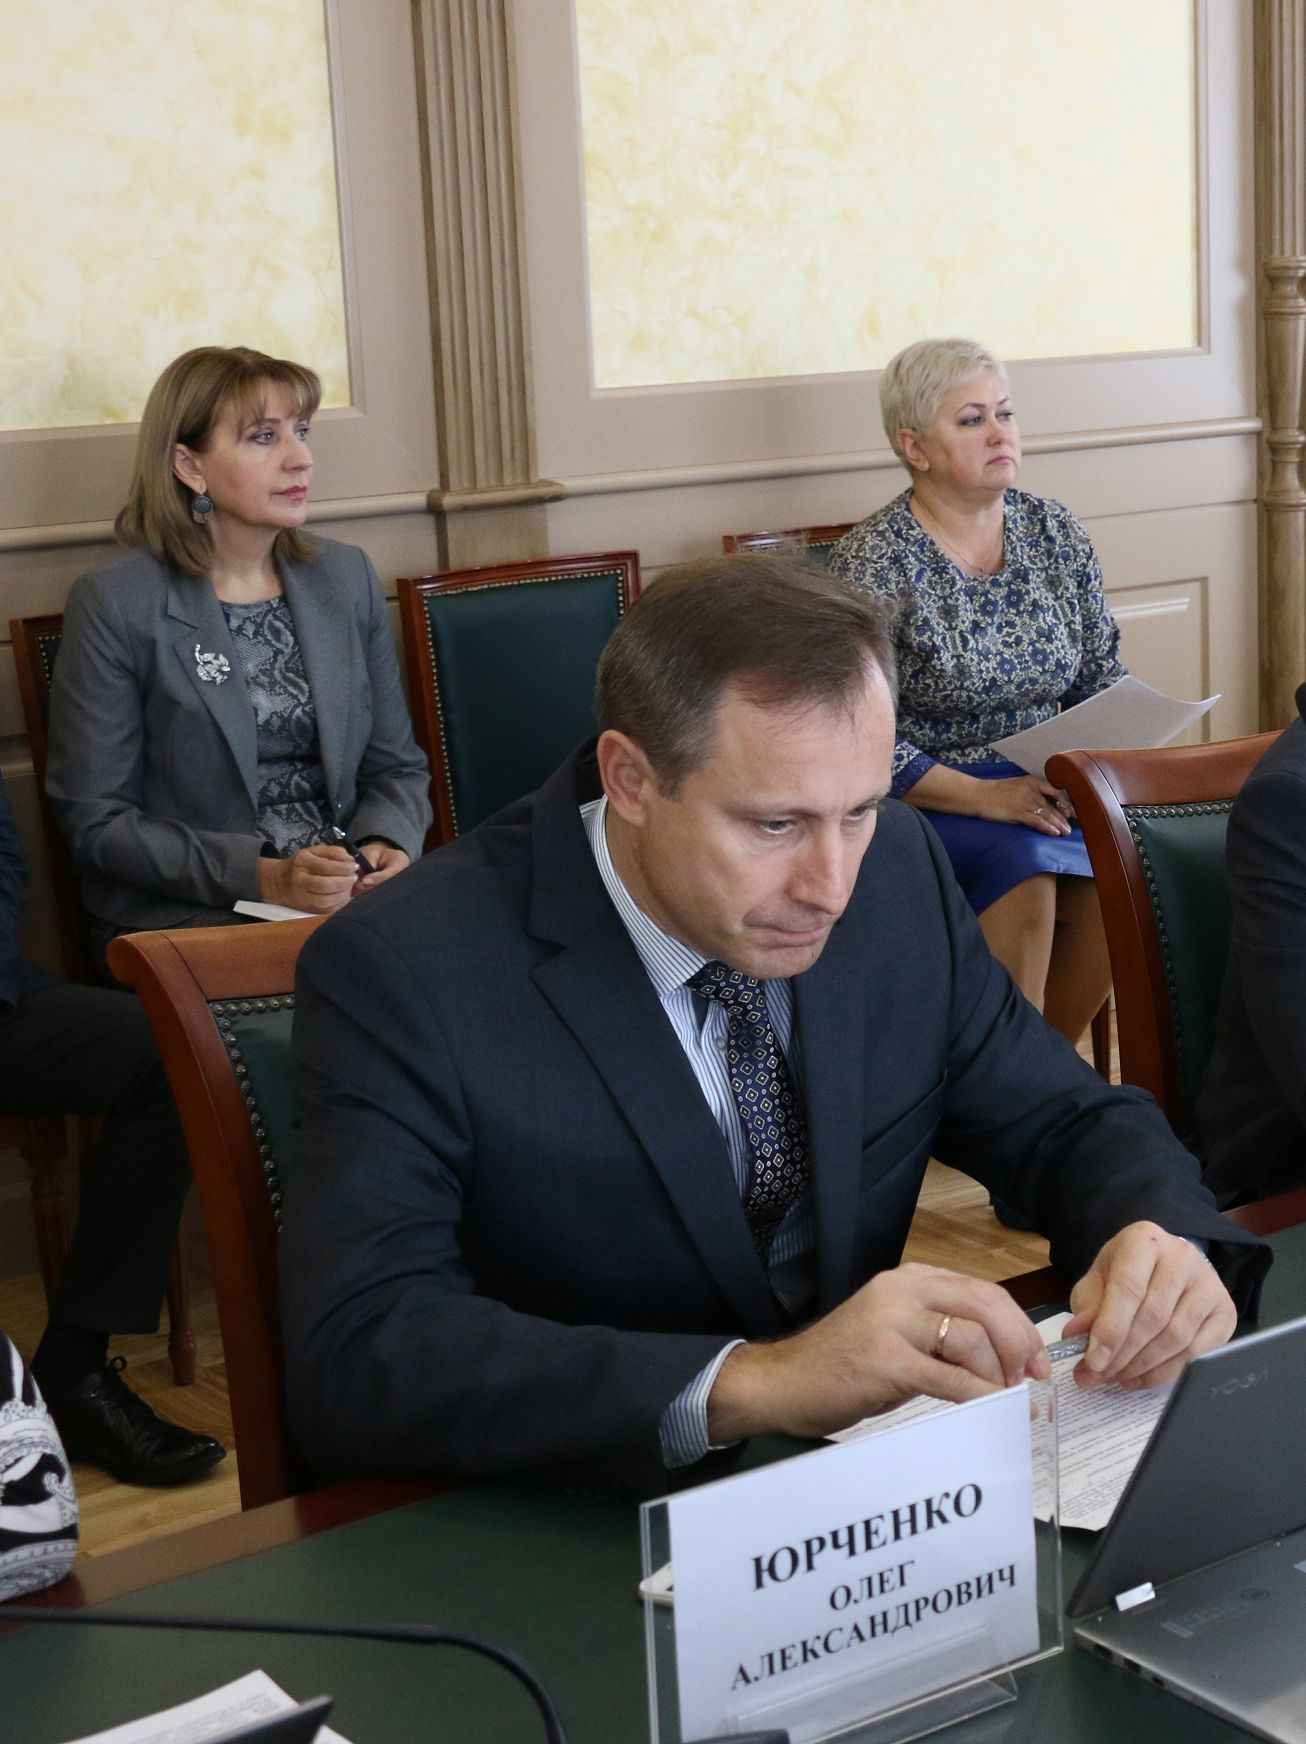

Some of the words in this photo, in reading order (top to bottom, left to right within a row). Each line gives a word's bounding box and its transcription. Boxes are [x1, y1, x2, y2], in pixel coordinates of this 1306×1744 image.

[751, 1483, 983, 1591] ЮРЧЕНКО
[828, 1559, 916, 1611] ОЛЕГ
[731, 1563, 1016, 1691] АЛЕКСАНДРОВИЧ
